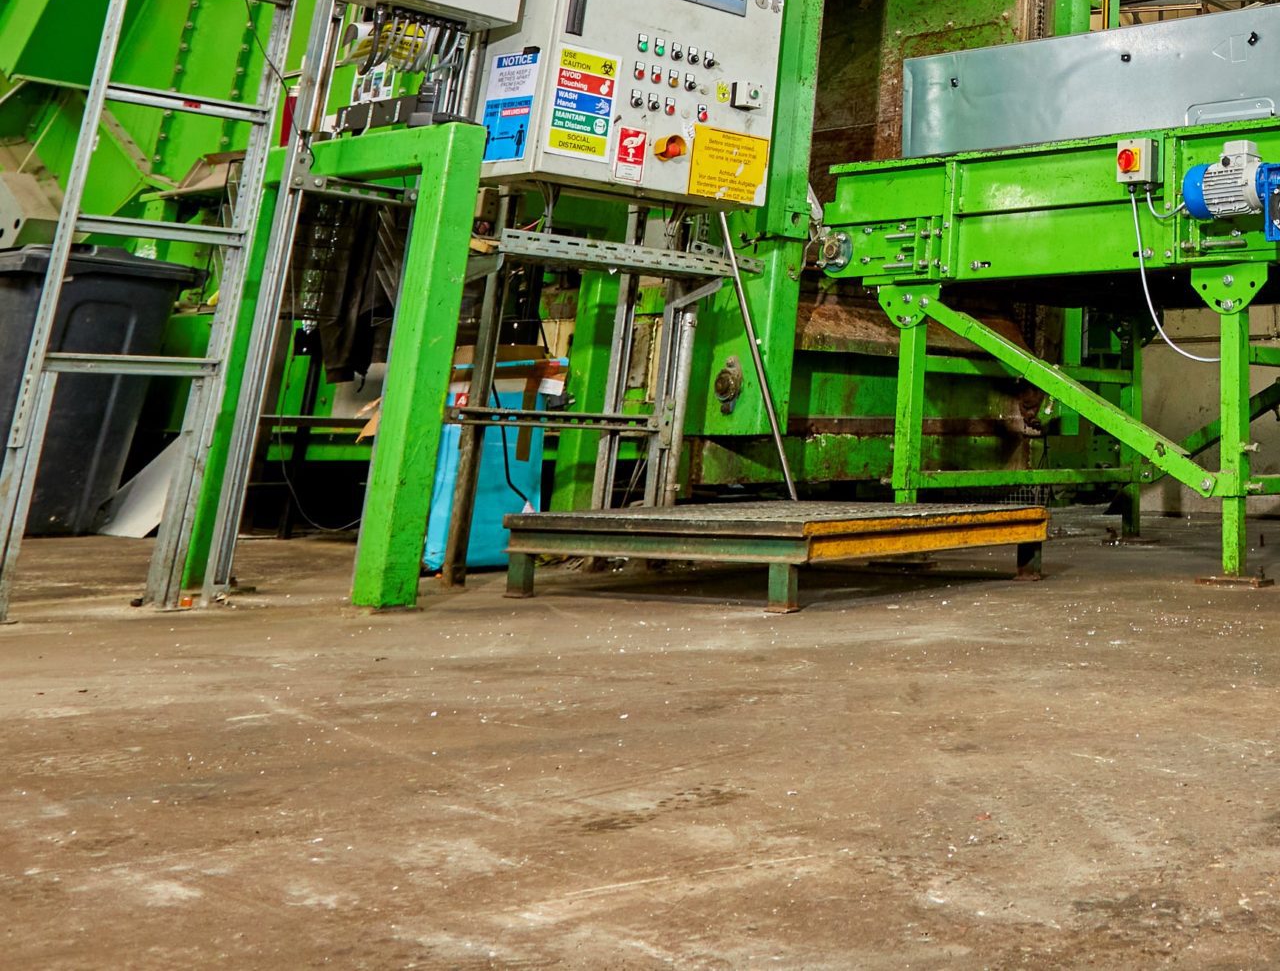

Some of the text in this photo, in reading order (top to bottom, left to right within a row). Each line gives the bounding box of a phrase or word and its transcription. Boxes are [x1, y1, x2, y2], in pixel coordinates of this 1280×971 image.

[502, 54, 534, 67] NOTICE
[564, 51, 577, 59] USE
[563, 59, 591, 71] CAUTION
[561, 69, 582, 80] AVOID
[560, 77, 588, 91] Touching
[558, 90, 578, 101] WASH
[556, 98, 577, 109] Hands
[555, 110, 586, 122] MAINTAIN
[553, 119, 591, 132] 2m Distance
[567, 133, 590, 144] SOCIAL
[558, 140, 596, 153] DISTANCING
